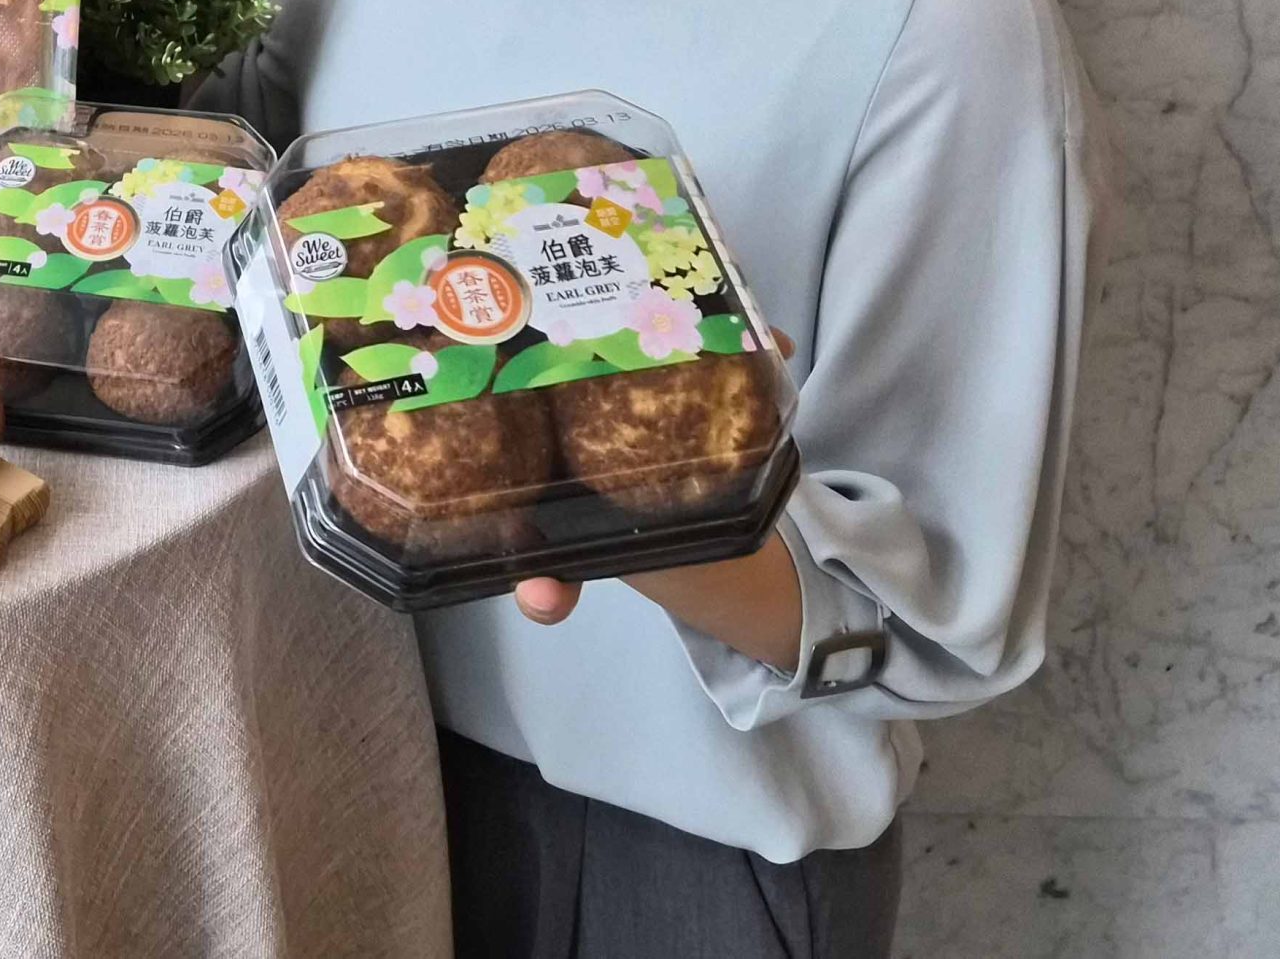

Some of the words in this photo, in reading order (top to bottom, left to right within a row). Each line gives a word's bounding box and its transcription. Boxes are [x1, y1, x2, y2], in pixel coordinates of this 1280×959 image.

[164, 206, 203, 225] 伯爵
[145, 221, 215, 242] 菠蘿泡芙
[295, 247, 343, 267] Sweet
[302, 238, 331, 256] We
[540, 234, 593, 262] 伯爵
[528, 254, 625, 286] 菠蘿泡芙
[456, 272, 494, 323] 春茶賞
[545, 288, 584, 302] EARL
[585, 282, 621, 297] GREY
